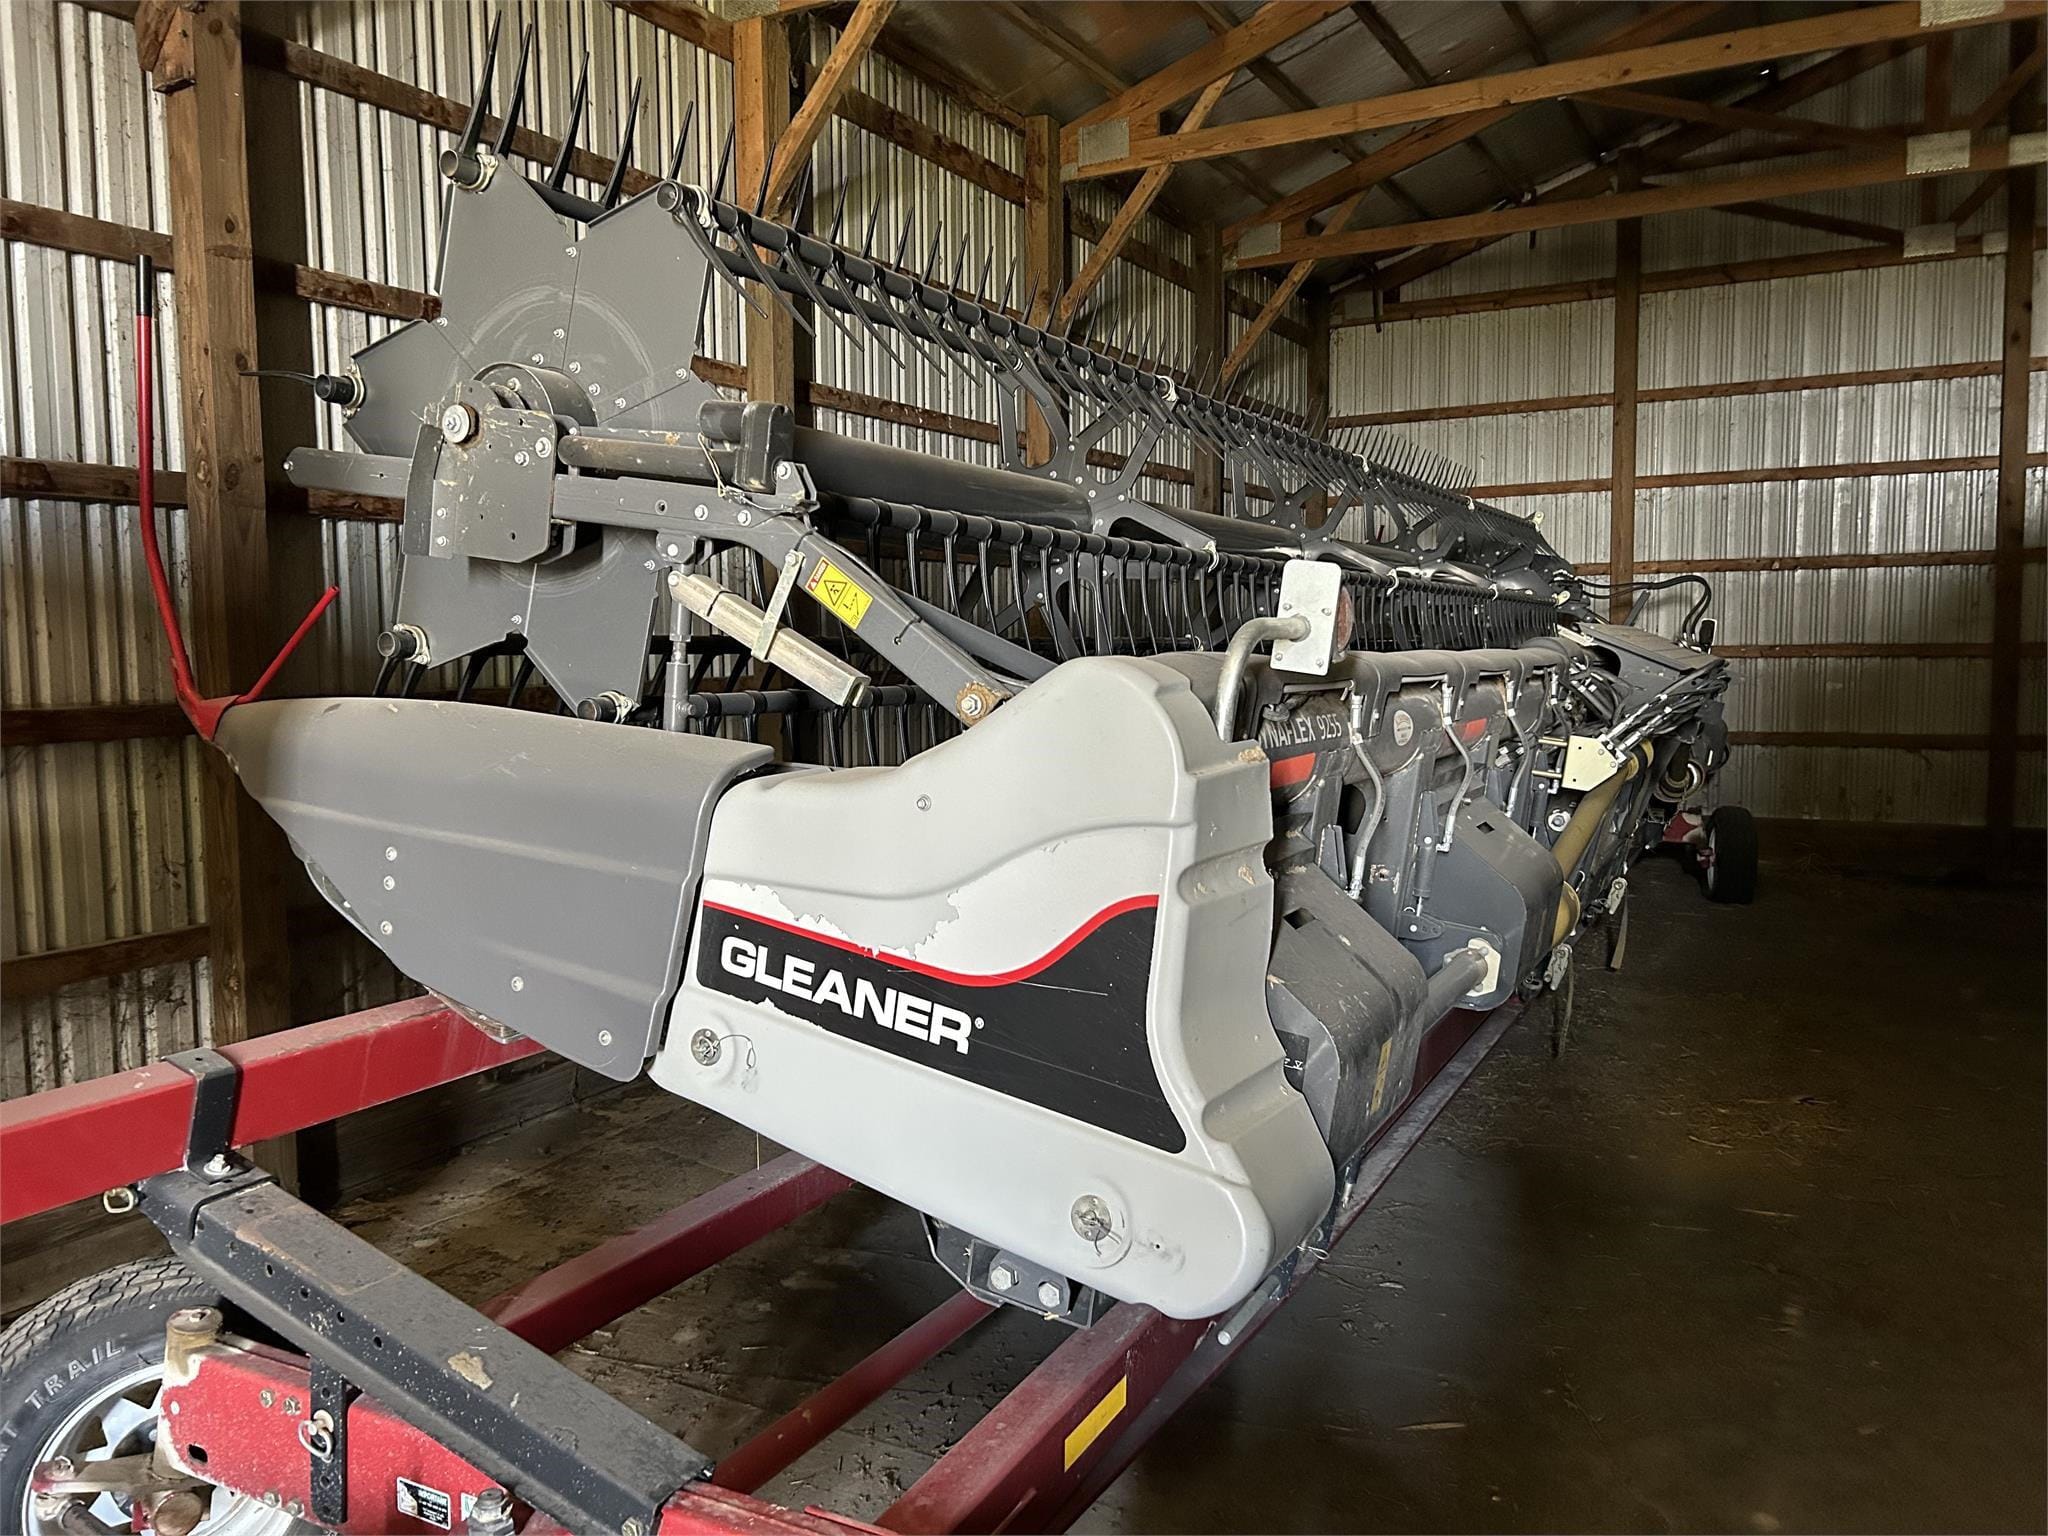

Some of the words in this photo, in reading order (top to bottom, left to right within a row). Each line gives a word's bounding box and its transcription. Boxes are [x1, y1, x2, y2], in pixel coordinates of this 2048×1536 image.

[1258, 713, 1316, 750] YNAFLEX
[1316, 713, 1342, 740] 9255
[24, 1340, 121, 1410] TRAIL
